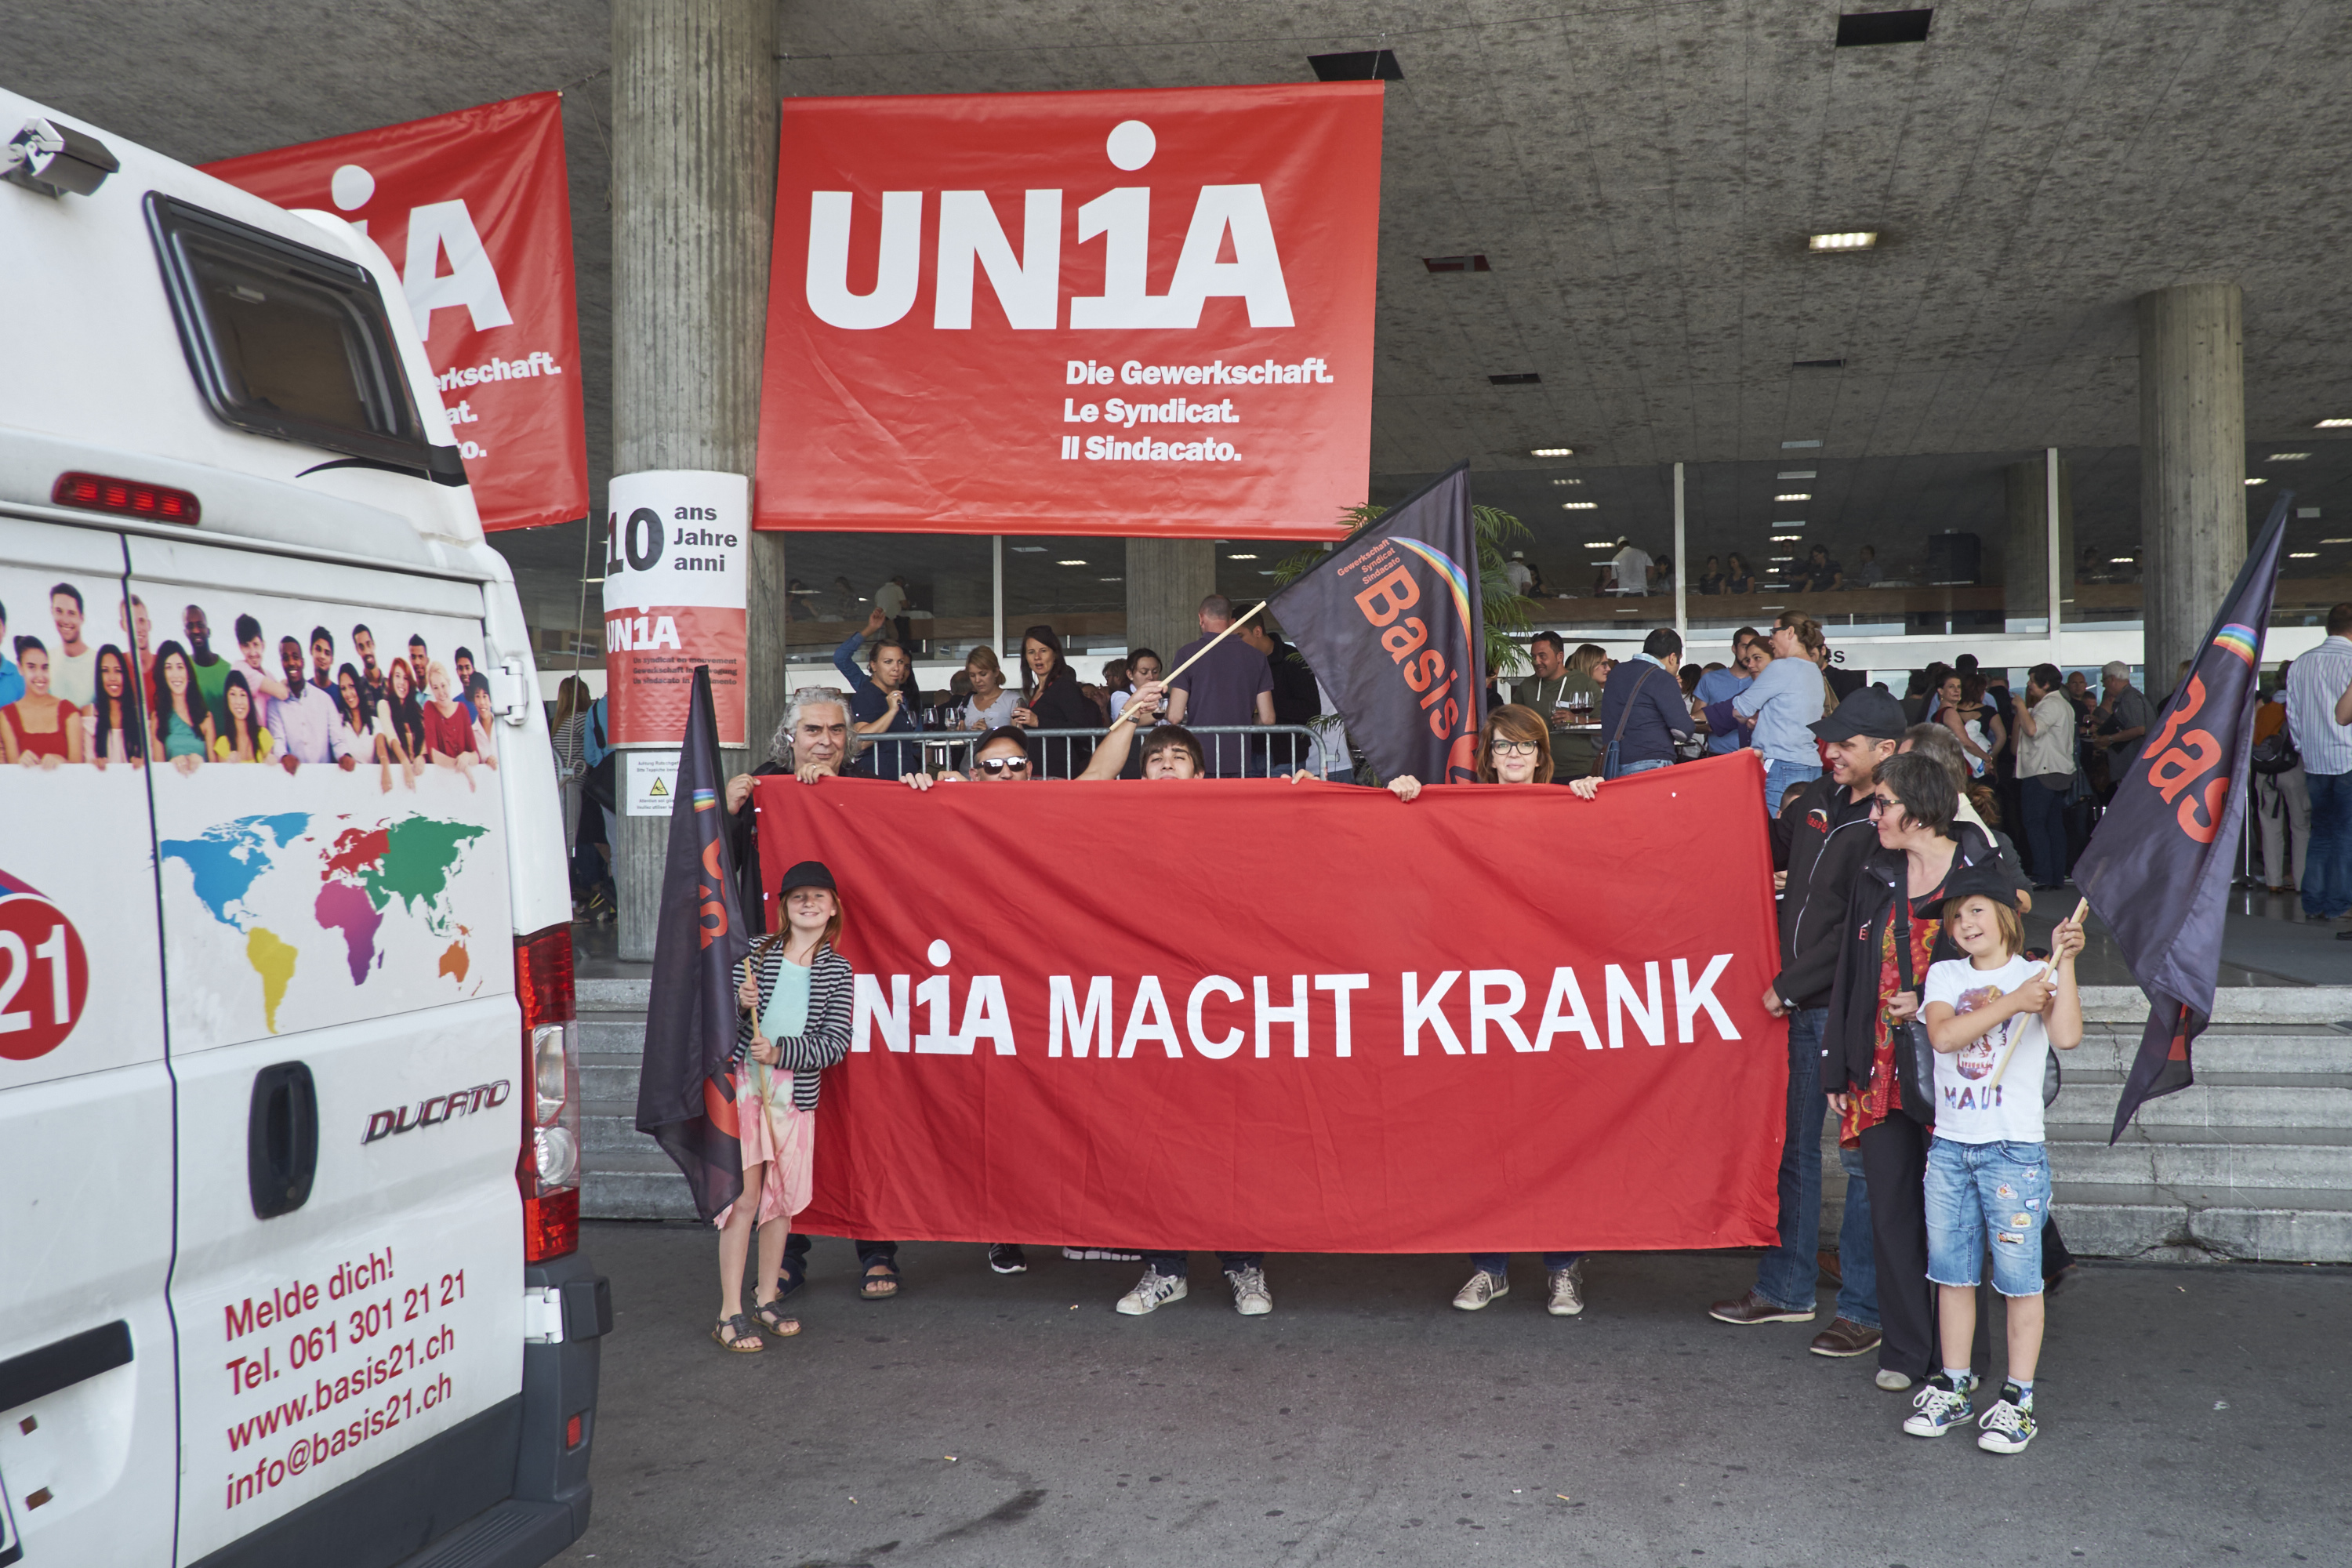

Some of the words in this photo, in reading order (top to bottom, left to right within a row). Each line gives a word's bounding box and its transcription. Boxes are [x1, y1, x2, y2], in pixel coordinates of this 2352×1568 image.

[1066, 360, 1115, 385] Die
[1120, 358, 1334, 385] Gewerkschaft.
[1064, 398, 1099, 423] Le
[1104, 397, 1240, 429] Syndicat.
[1062, 436, 1080, 460] Il
[1084, 435, 1242, 462] Sindacato.
[673, 528, 739, 547] Jahre
[674, 506, 718, 521] ans
[607, 507, 665, 577] 10
[674, 554, 726, 572] anni
[1337, 539, 1391, 577] Gewerkschaft
[1360, 547, 1396, 573] Syndicat
[1362, 556, 1401, 585] Sindacato
[1353, 564, 1459, 740] Basis
[0, 923, 71, 1034] 21
[1047, 973, 1370, 1059] MACHT
[1403, 953, 1741, 1057] KRANK
[361, 1079, 510, 1145] DUCATO
[224, 1280, 320, 1342] Melde
[328, 1246, 394, 1301] dich!
[226, 1346, 280, 1396] Tel.
[289, 1320, 337, 1370] 061
[349, 1298, 393, 1345] 301
[404, 1283, 430, 1323] 21
[441, 1269, 465, 1308] 21
[227, 1323, 454, 1453] www.basis21.ch
[227, 1372, 452, 1510] info@basis21.ch
